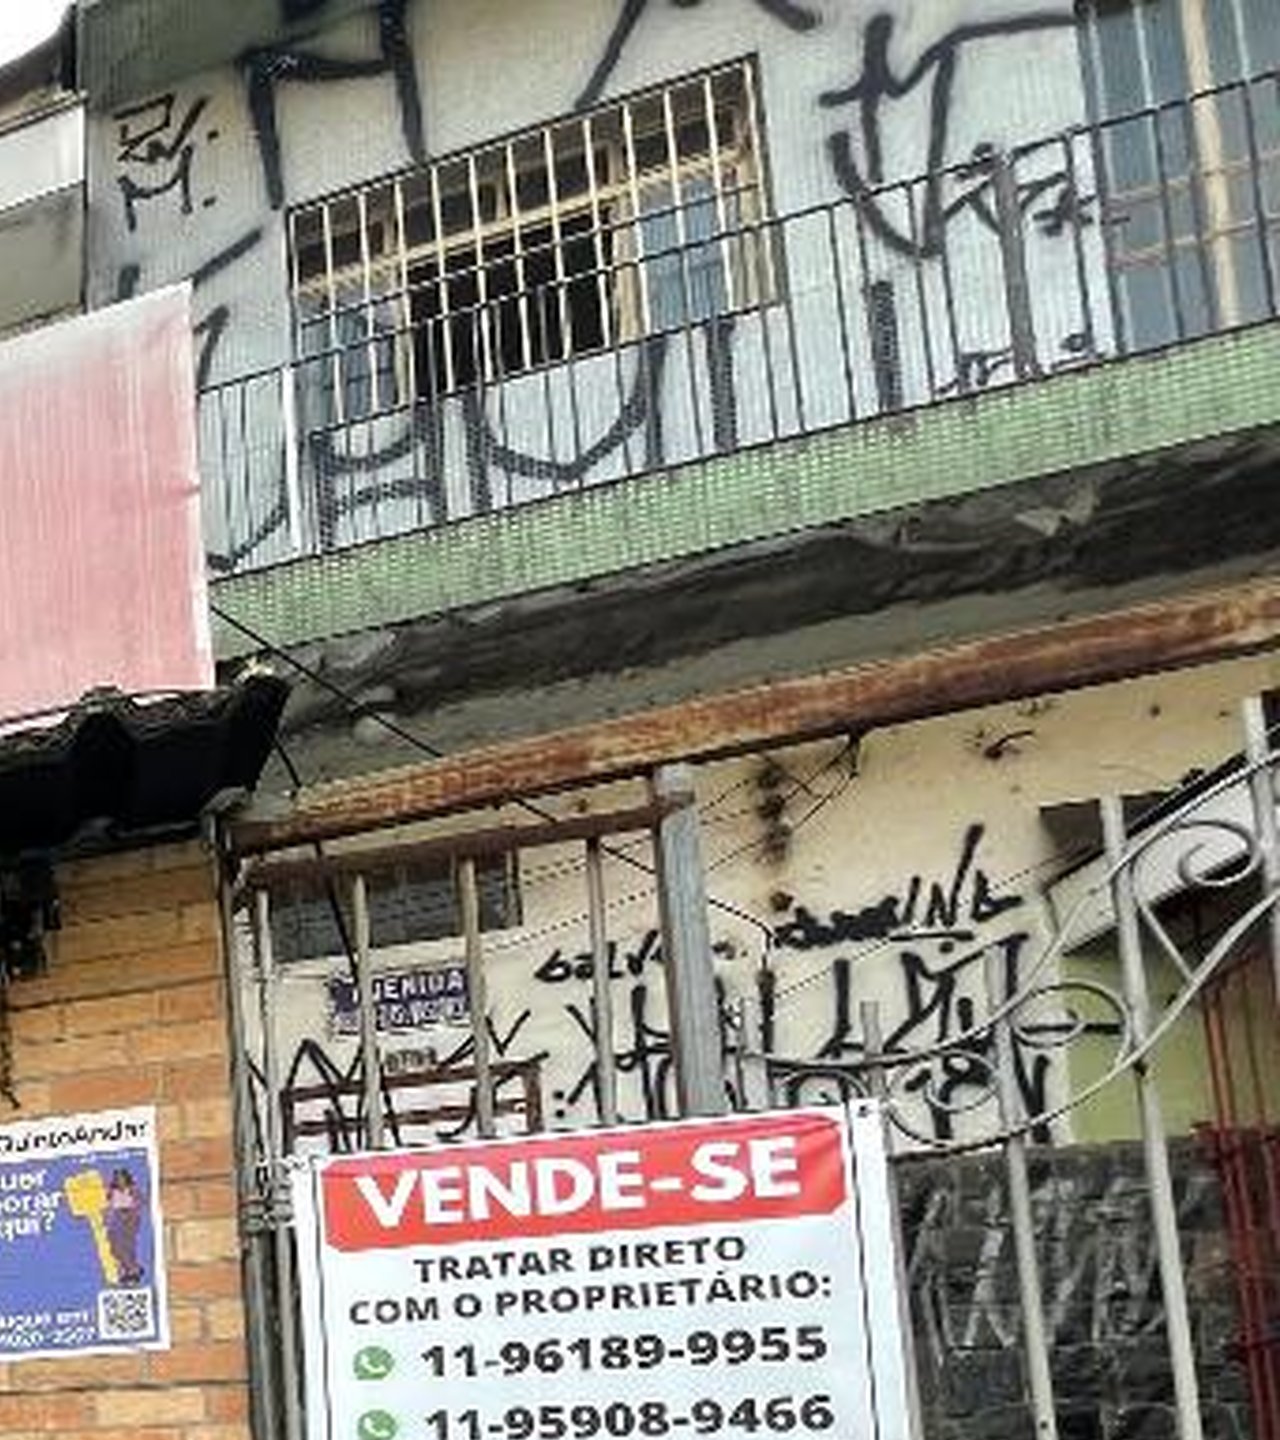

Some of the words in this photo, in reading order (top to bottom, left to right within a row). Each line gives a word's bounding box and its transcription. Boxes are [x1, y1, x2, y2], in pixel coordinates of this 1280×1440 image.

[353, 1136, 802, 1229] VENDE-SE
[413, 1246, 574, 1285] TRATAR
[588, 1236, 747, 1273] DIRETO
[348, 1295, 441, 1327] COM
[453, 1293, 483, 1320] O
[495, 1269, 833, 1319] PROPRIETÁRIO:
[420, 1325, 829, 1378] 11-96189-9955
